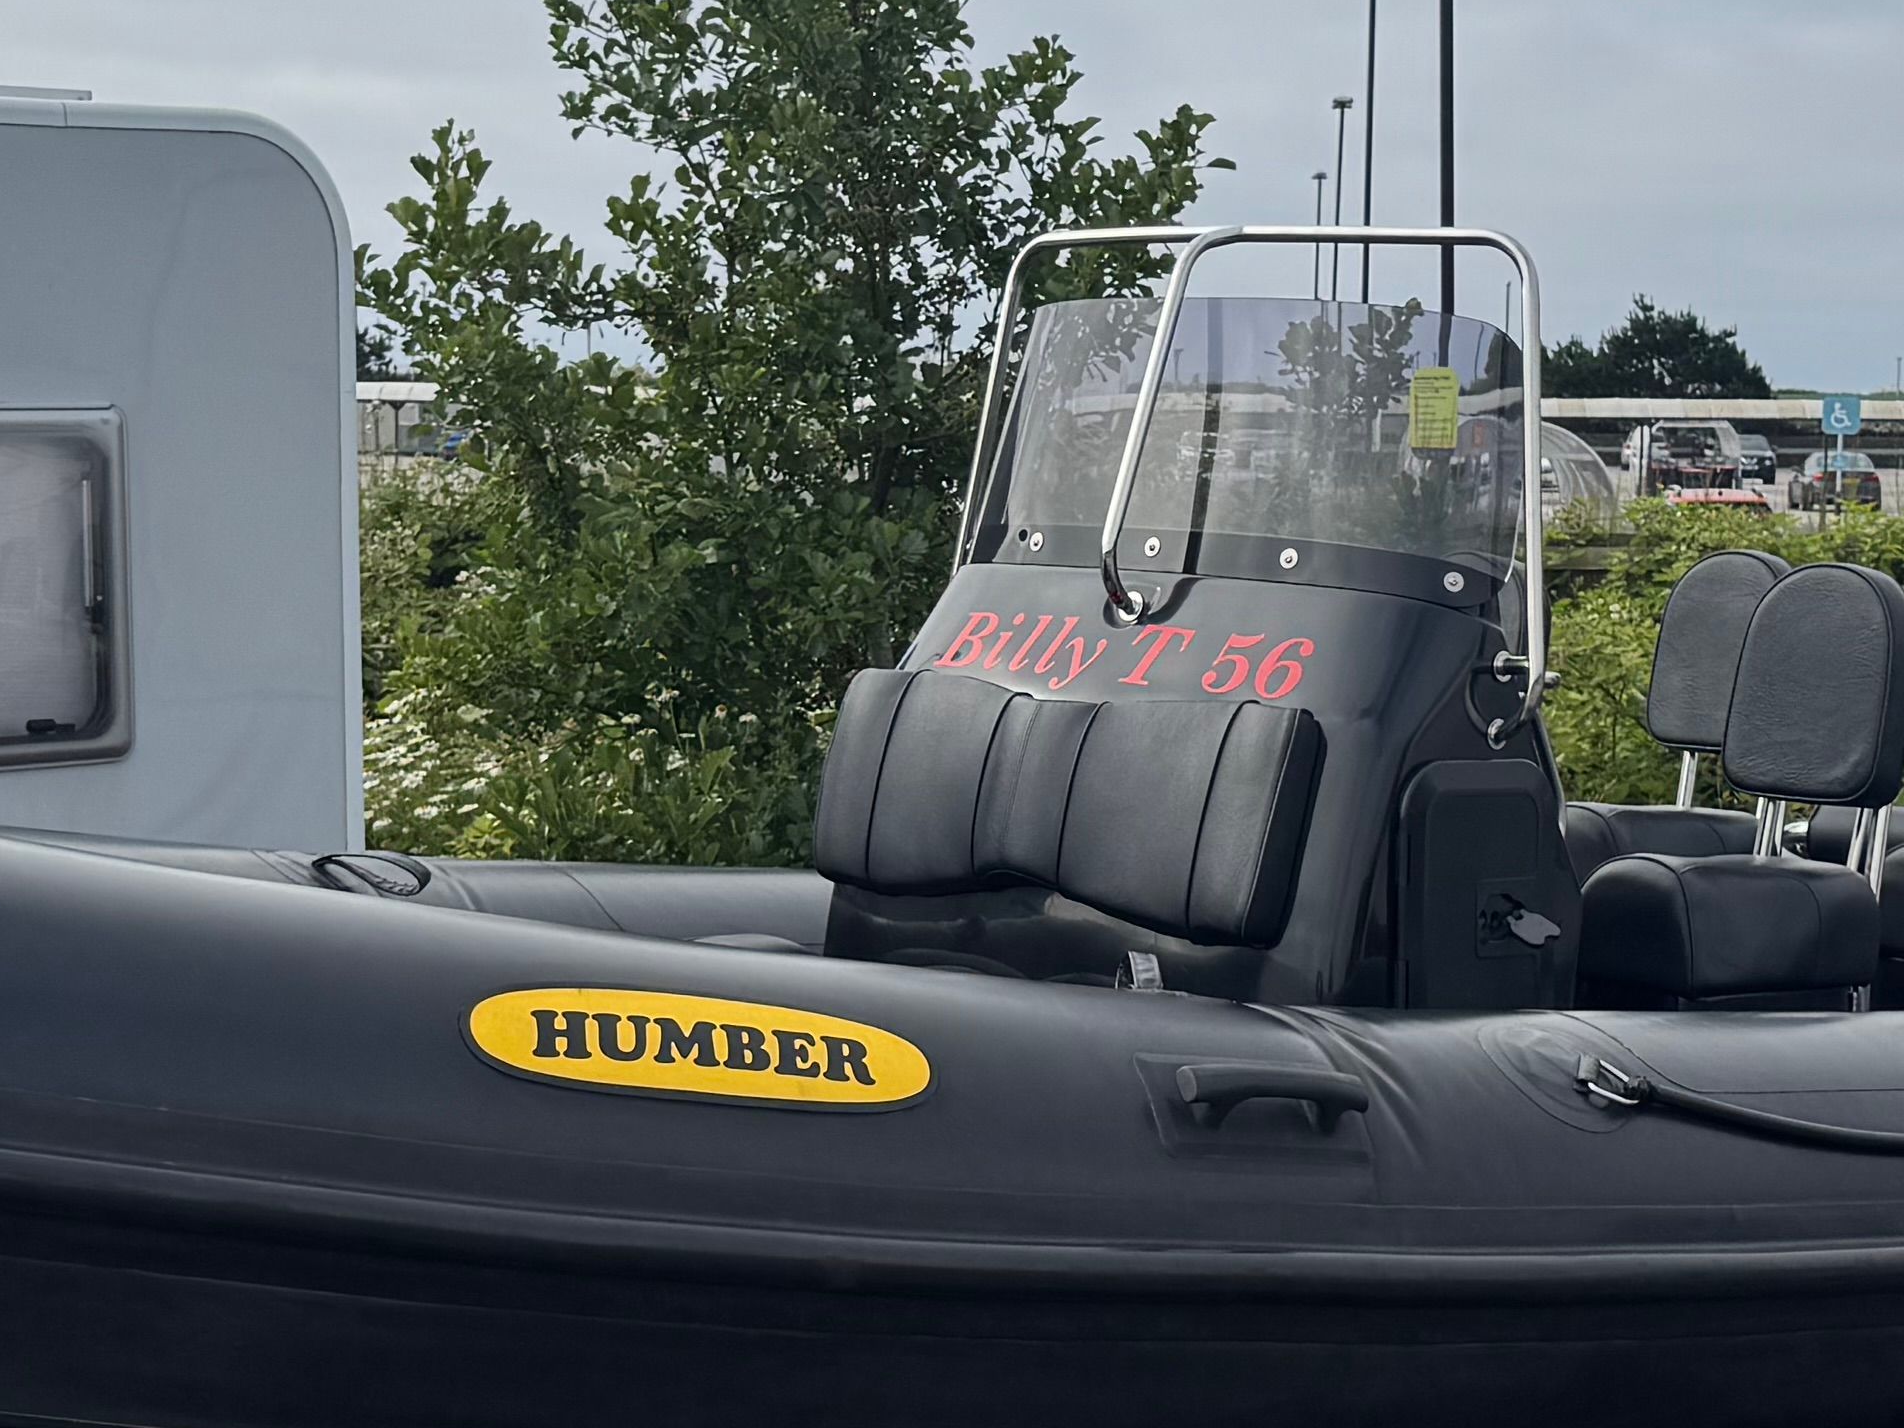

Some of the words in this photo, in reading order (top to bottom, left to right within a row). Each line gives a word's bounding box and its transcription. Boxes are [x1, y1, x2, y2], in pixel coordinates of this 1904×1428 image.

[933, 611, 1108, 690] Billy
[1117, 623, 1197, 687] T
[1200, 632, 1316, 700] 56
[530, 1009, 876, 1086] HUMBER
